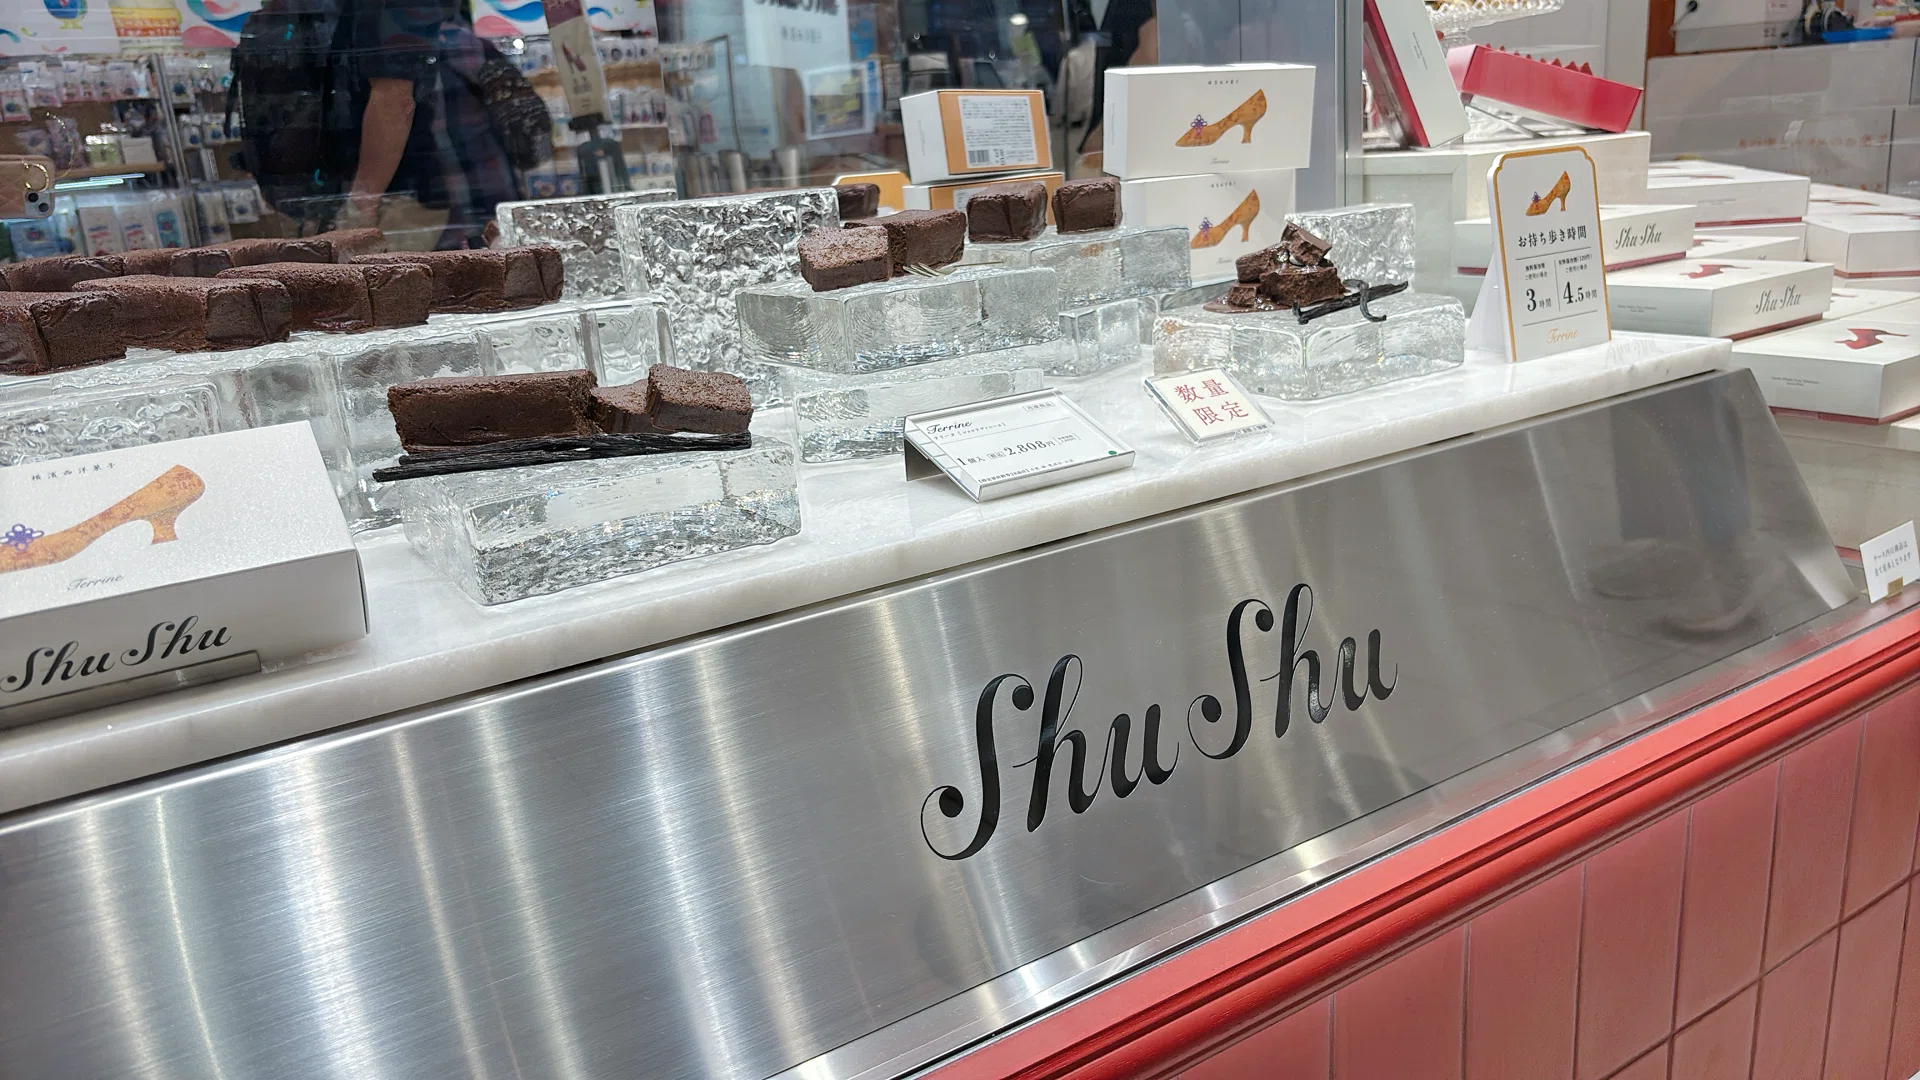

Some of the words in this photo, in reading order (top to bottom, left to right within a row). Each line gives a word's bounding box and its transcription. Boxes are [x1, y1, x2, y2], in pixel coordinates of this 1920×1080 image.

[1518, 225, 1588, 248] お持ち歩き時間
[1546, 328, 1579, 345] Terrine
[1173, 378, 1229, 405] 数量
[1193, 399, 1250, 426] 限定
[927, 421, 973, 435] Terrine
[1004, 440, 1056, 456] 2,808円
[67, 574, 126, 592] Terrine
